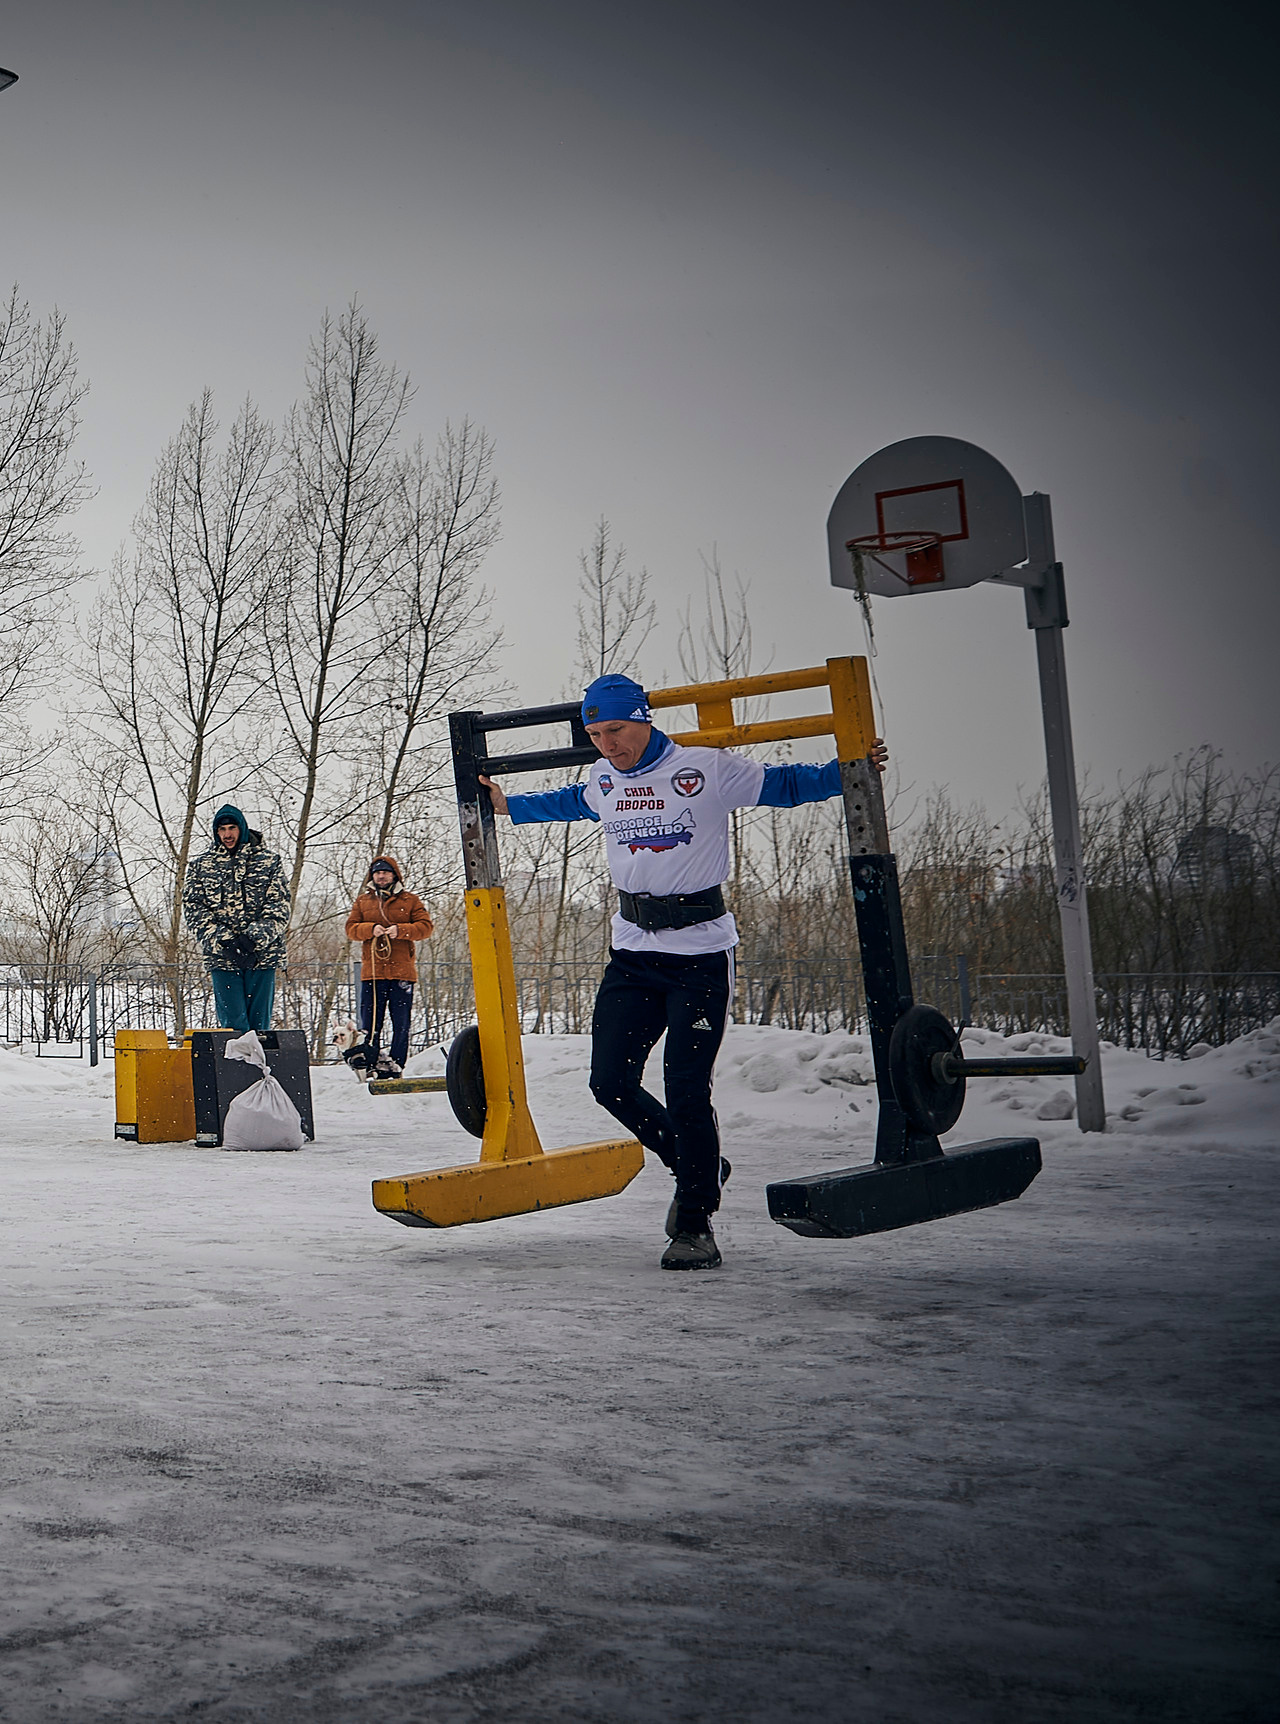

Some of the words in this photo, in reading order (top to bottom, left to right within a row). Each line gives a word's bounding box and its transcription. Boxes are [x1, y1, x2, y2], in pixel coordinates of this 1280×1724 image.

[624, 786, 655, 797] СИЛА
[615, 800, 665, 811] ДВОРОВ
[616, 823, 684, 840] ОТЕЧЕСТВО
